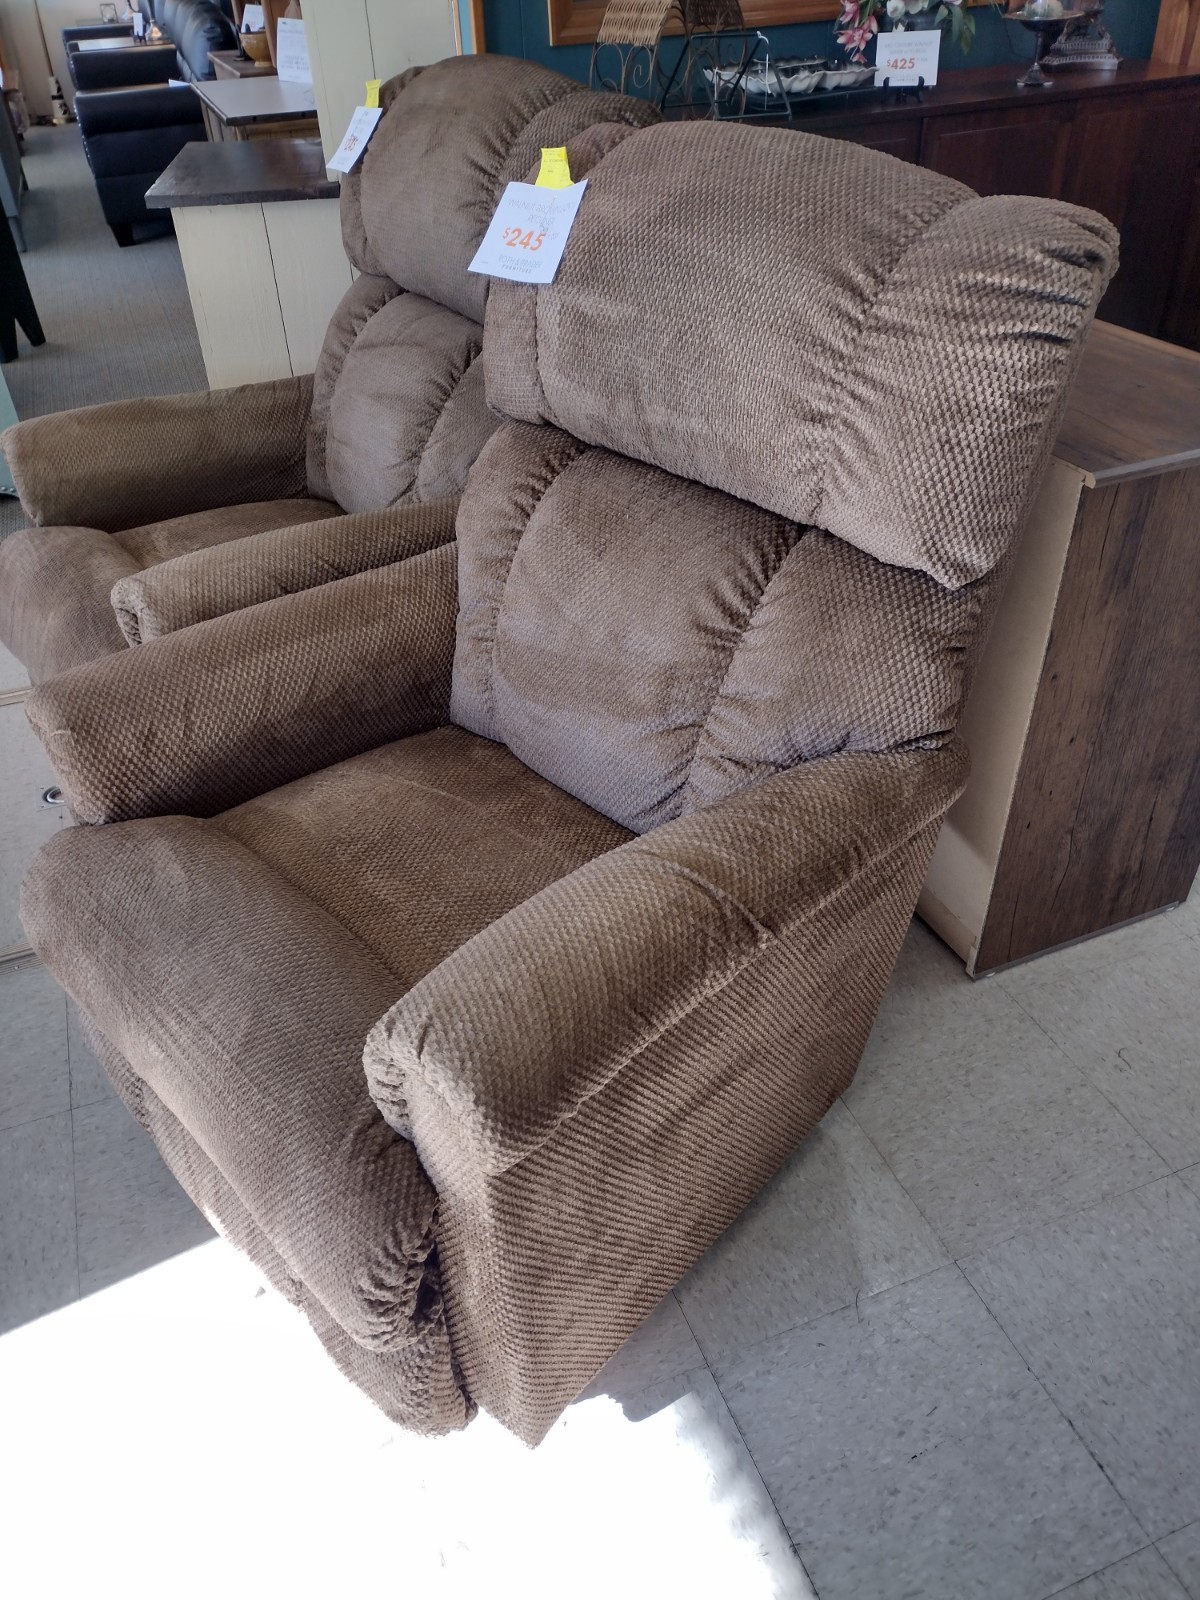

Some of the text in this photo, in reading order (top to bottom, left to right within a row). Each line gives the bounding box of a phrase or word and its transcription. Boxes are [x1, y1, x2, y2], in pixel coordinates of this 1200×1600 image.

[887, 57, 915, 70] $425
[502, 226, 547, 251] $245
[501, 264, 532, 274] FURNITURE
